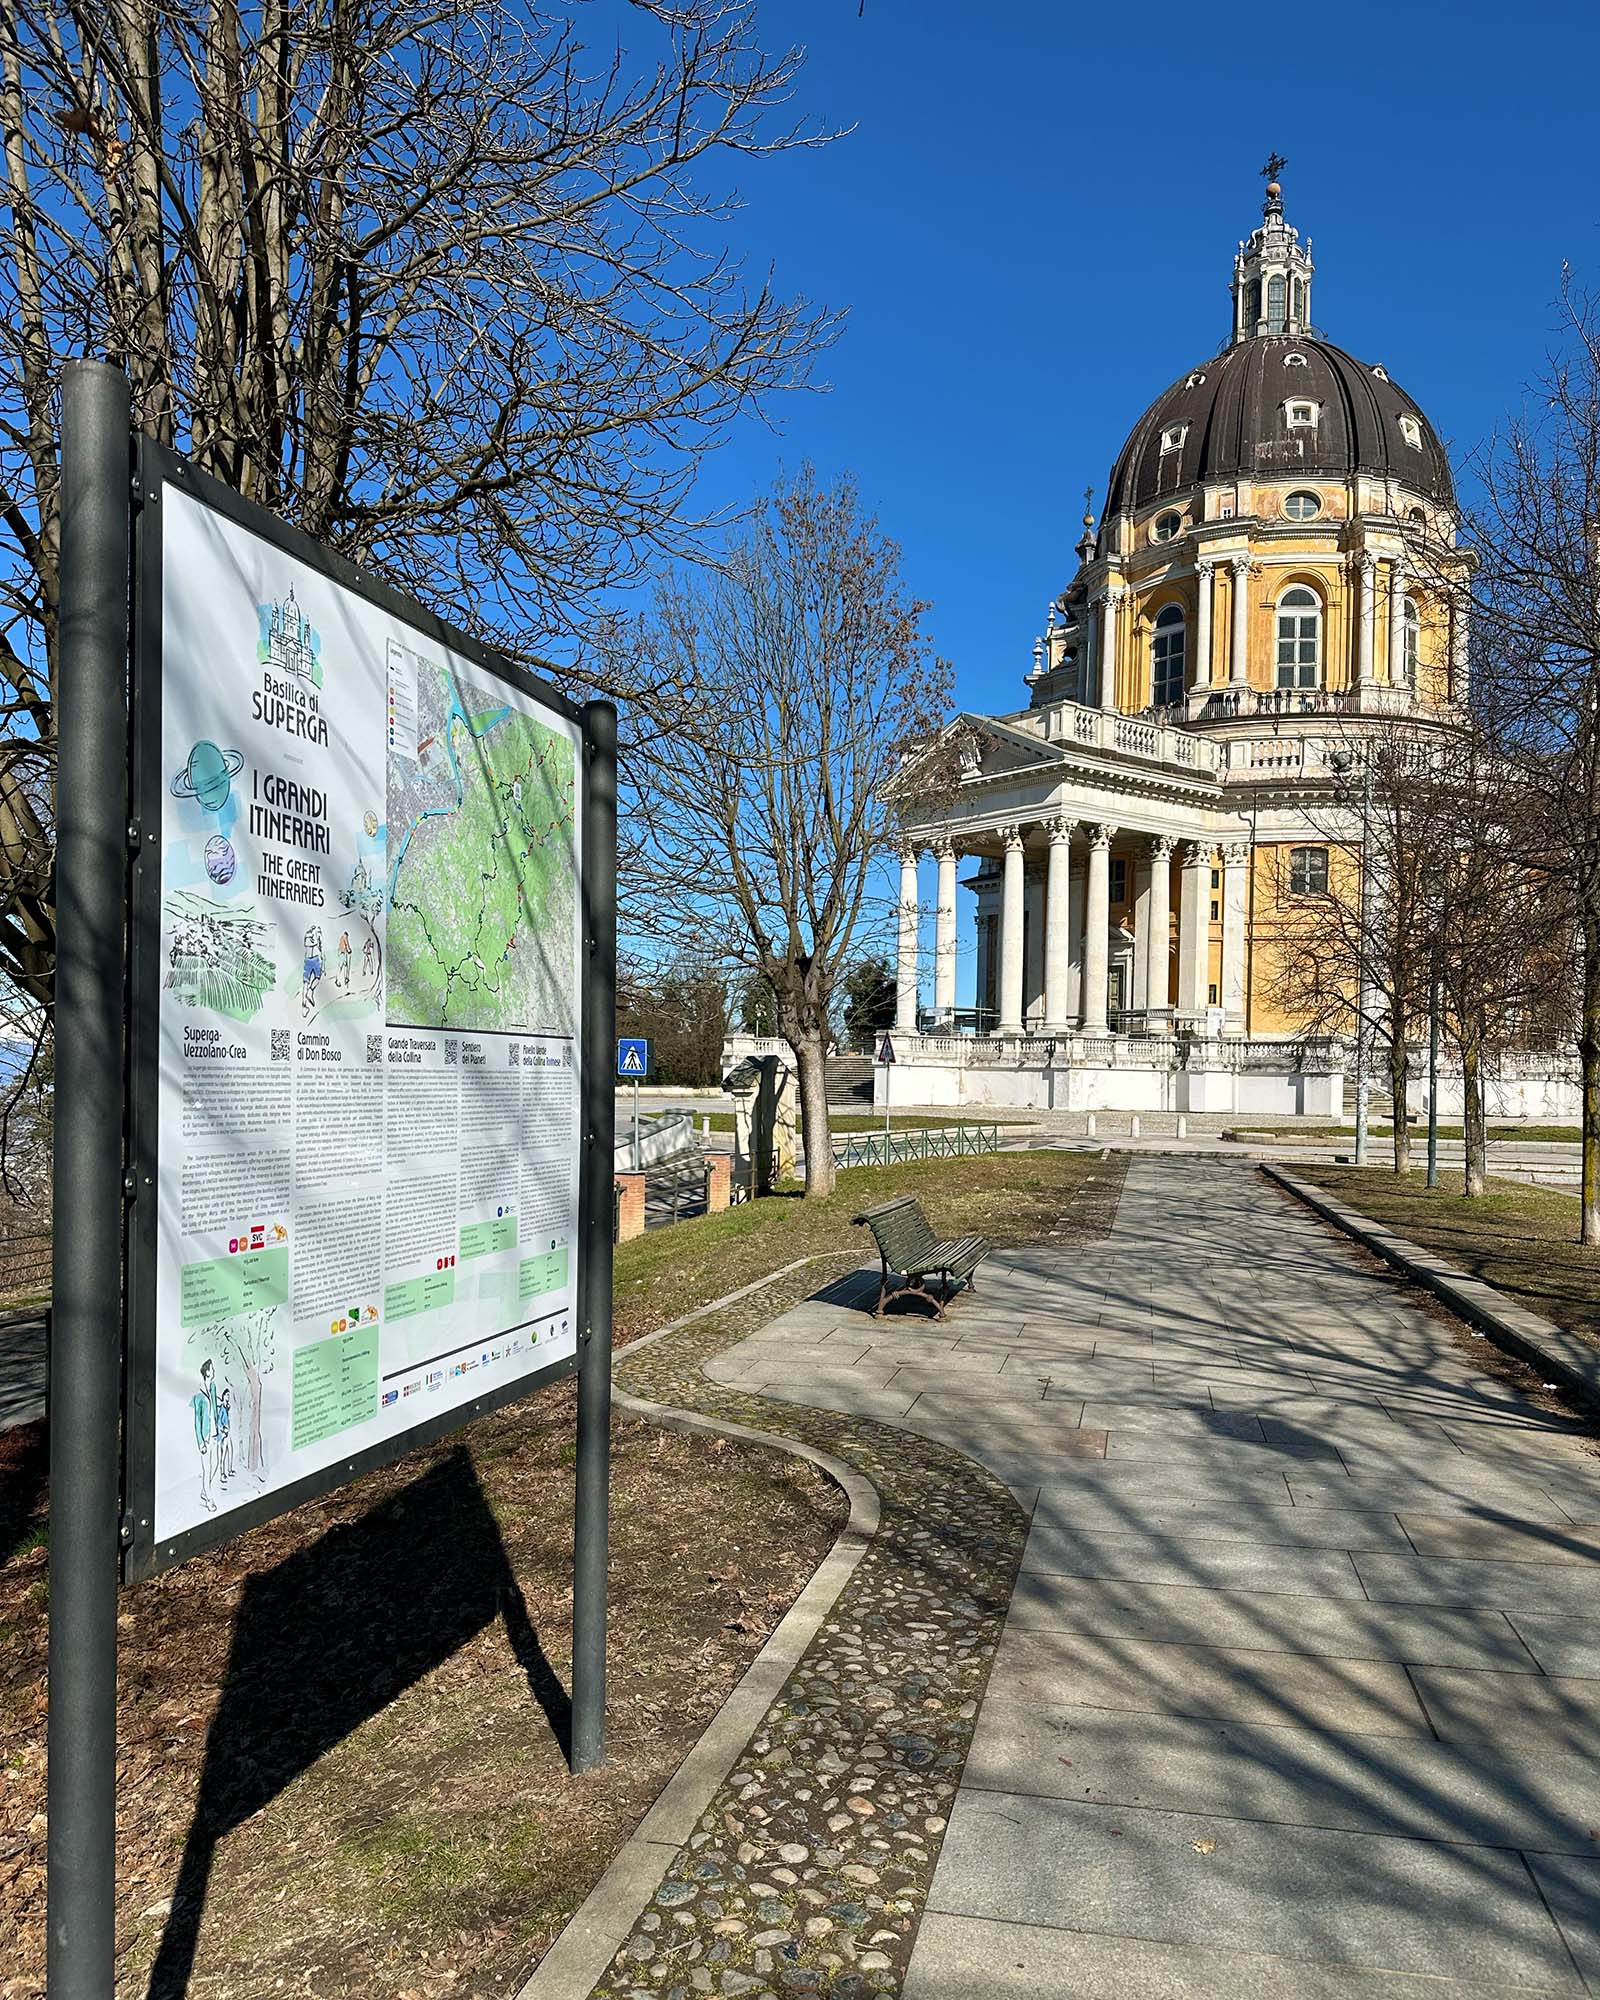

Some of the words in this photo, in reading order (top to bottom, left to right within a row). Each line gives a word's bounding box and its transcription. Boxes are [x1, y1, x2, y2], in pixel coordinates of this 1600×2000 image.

[264, 671, 306, 708] Basilica
[308, 693, 319, 713] di
[252, 691, 329, 748] SUPERGA
[253, 769, 258, 800] I
[263, 775, 327, 821] GRANDI
[250, 804, 330, 855] ITINERARI
[262, 852, 283, 876] THE
[287, 859, 321, 885] GREAT
[257, 875, 325, 908] ITINERARIES
[184, 1026, 222, 1043] Superga-
[297, 1032, 329, 1046] Cammino
[183, 1044, 247, 1060] Vezzolano-Crea
[388, 1037, 408, 1049] Grande
[409, 1038, 436, 1051] Traversata
[462, 1041, 481, 1053] Sentiero
[297, 1048, 304, 1060] di
[305, 1049, 320, 1061] Don
[321, 1050, 341, 1062] Bosco
[388, 1051, 402, 1063] della
[403, 1051, 422, 1063] Collina
[470, 1055, 486, 1065] Pianeti
[252, 1233, 263, 1242] SVC
